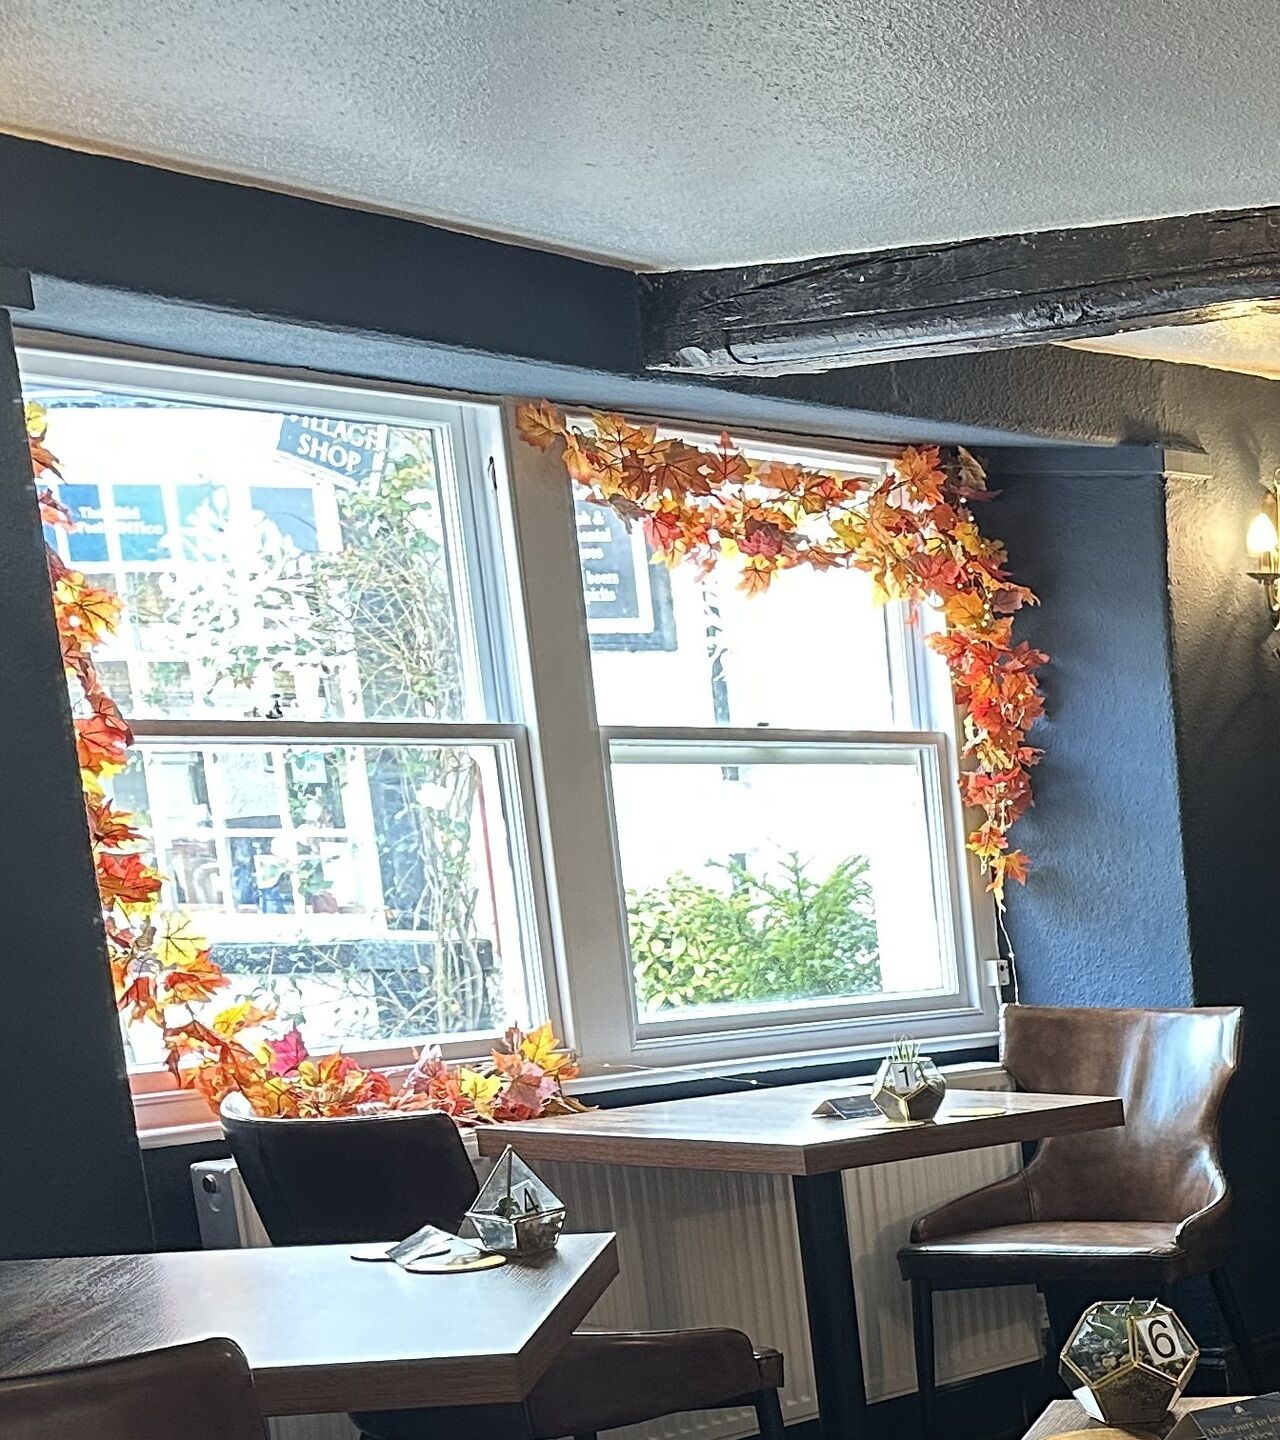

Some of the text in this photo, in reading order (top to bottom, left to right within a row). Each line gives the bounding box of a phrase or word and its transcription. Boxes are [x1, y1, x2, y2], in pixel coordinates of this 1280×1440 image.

[297, 434, 361, 472] SHOP
[898, 1066, 910, 1087] 1
[523, 1187, 539, 1214] 4
[1148, 1320, 1176, 1358] 6
